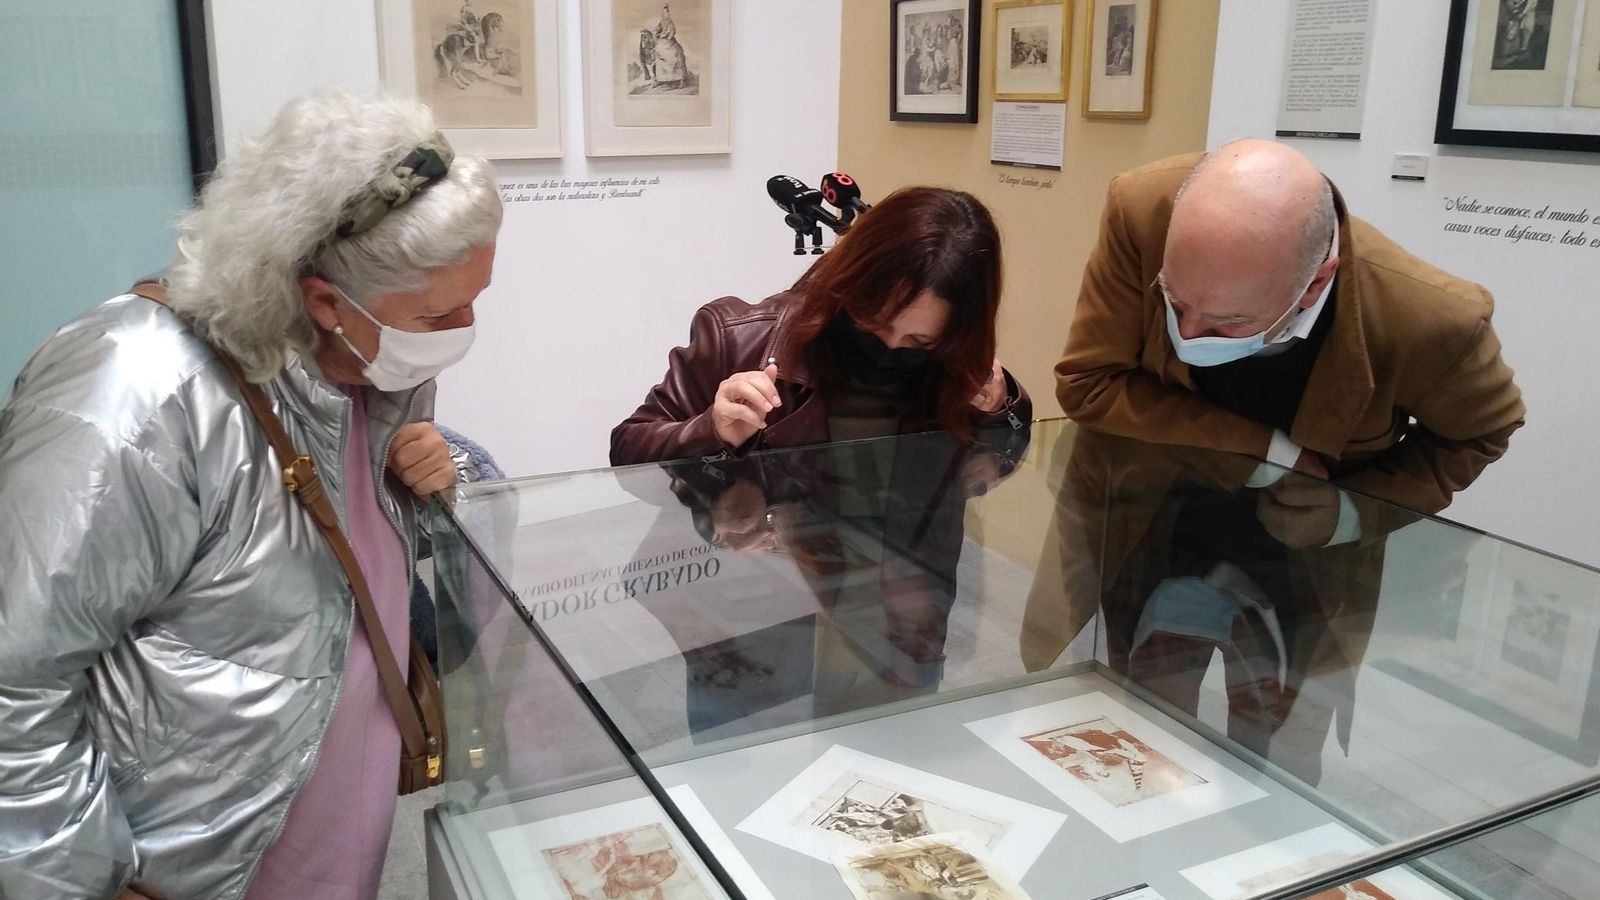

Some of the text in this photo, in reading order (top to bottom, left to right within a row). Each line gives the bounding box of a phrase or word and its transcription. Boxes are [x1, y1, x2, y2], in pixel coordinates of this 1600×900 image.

[540, 180, 548, 188] de
[549, 180, 558, 188] las
[558, 192, 566, 200] la
[1481, 205, 1495, 215] se
[1534, 205, 1550, 219] el
[1548, 208, 1590, 224] mundo
[1444, 221, 1472, 233] caras
[1474, 225, 1501, 237] voces
[1560, 229, 1588, 246] todo
